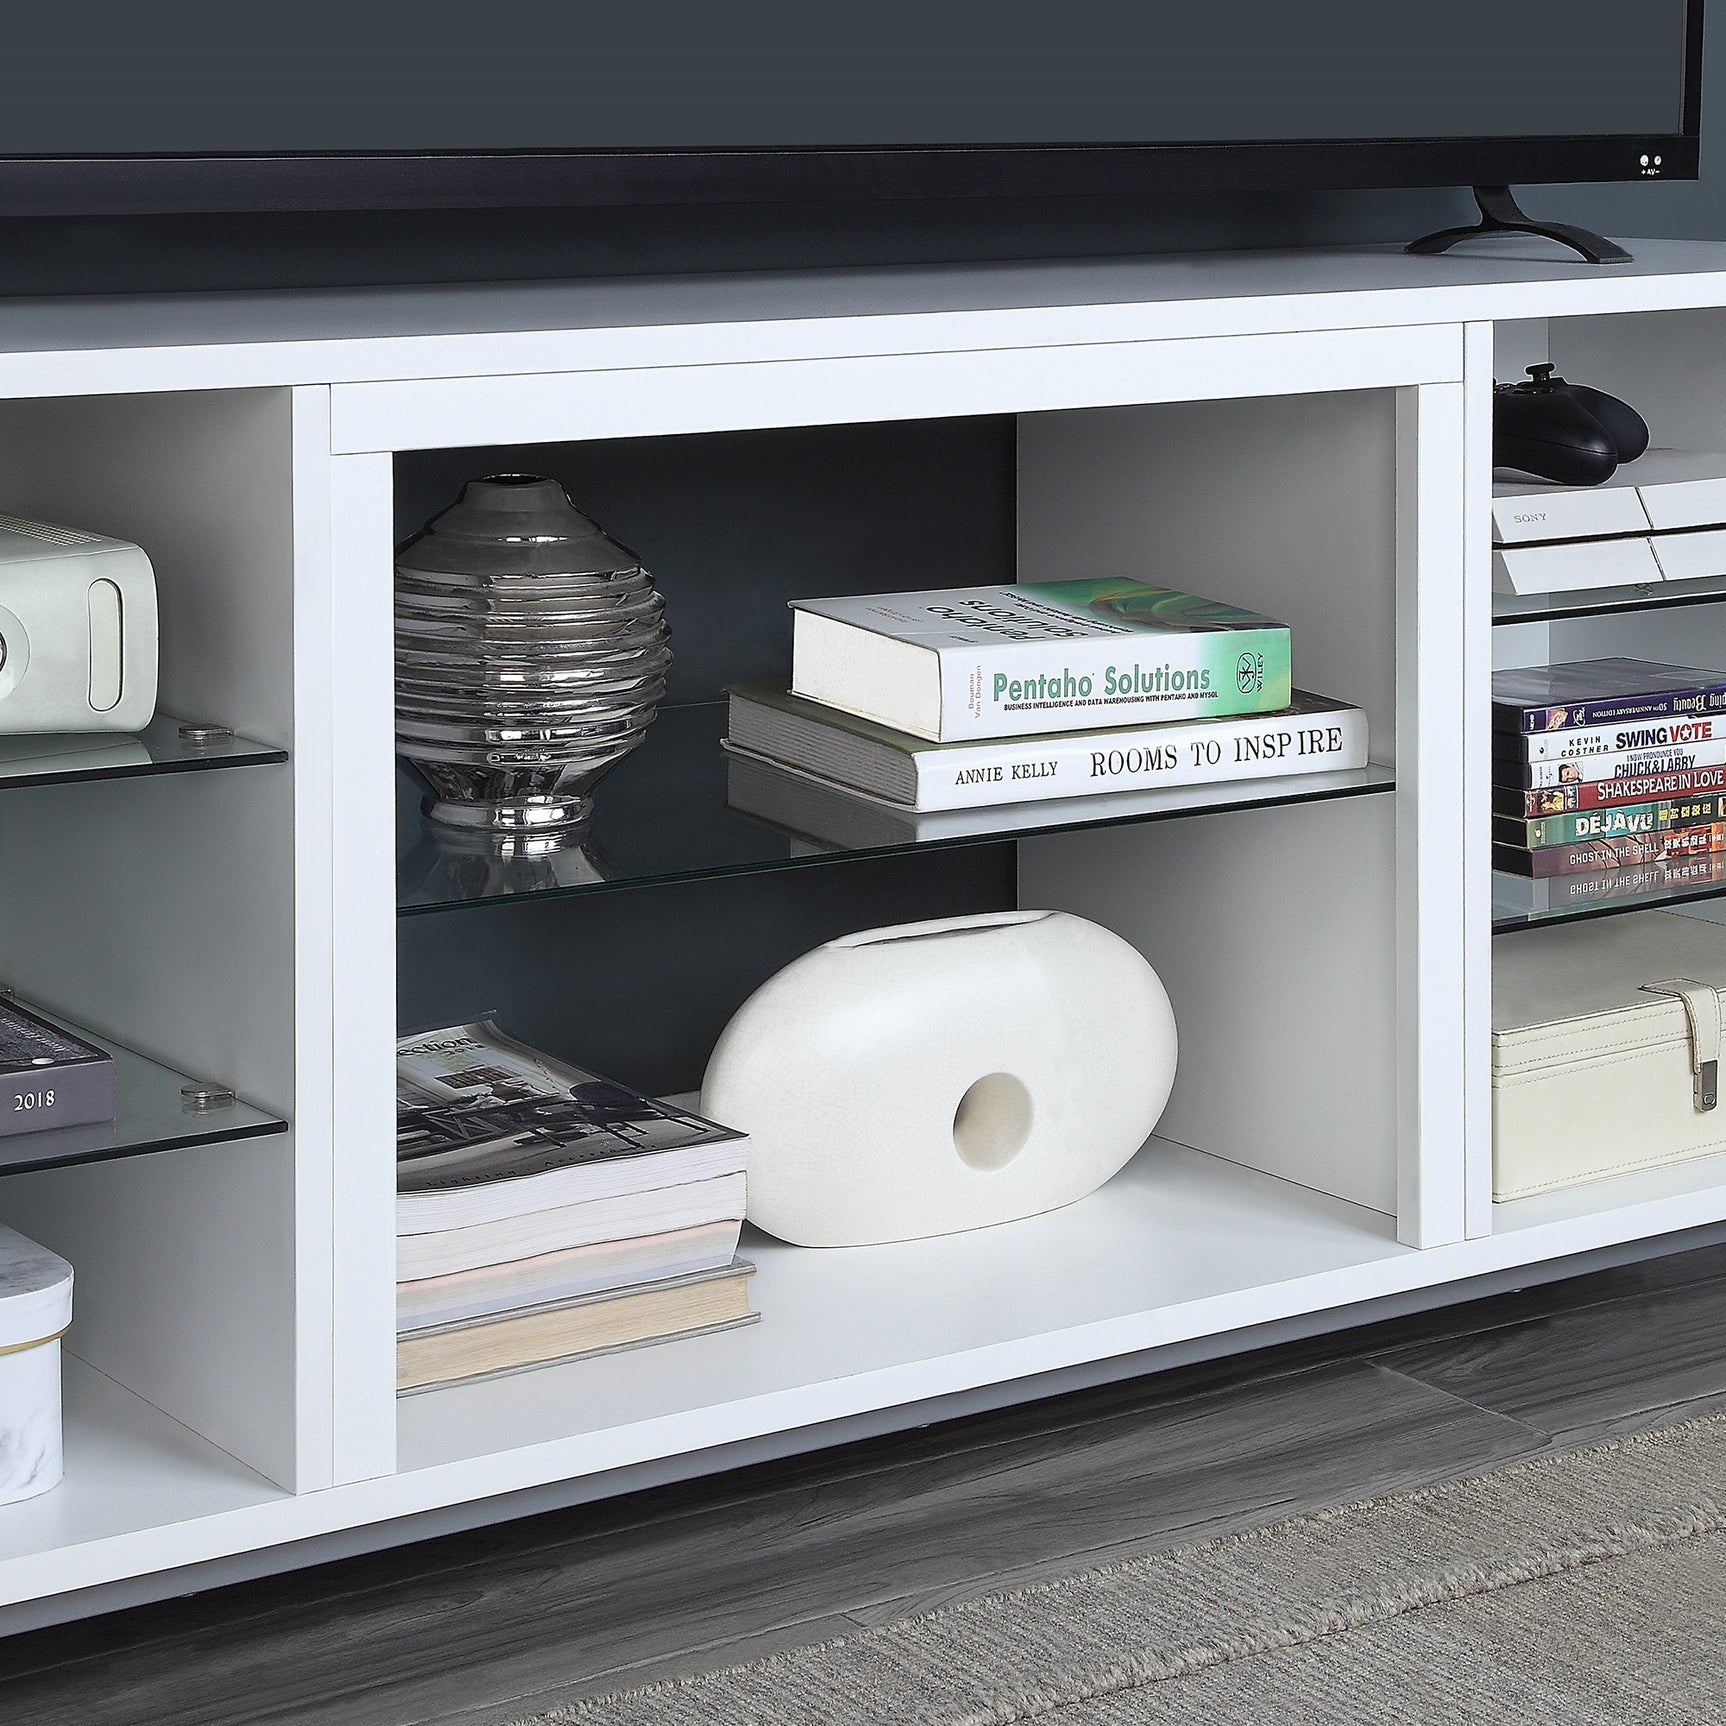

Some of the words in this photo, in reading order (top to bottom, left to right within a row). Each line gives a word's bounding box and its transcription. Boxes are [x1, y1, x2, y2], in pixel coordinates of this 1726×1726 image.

[1514, 513, 1547, 523] SONY
[926, 605, 1046, 641] Pentaho
[958, 600, 1089, 638] Solutions
[975, 665, 983, 699] Dongen
[993, 667, 1095, 702] Pentaho
[1104, 663, 1211, 696] Solutions
[1256, 652, 1264, 693] WILEY
[967, 673, 975, 710] Bouman
[1003, 702, 1033, 711] BUSINESS
[1033, 699, 1074, 710] INTELLIGENCE
[1074, 699, 1088, 707] AND
[1088, 698, 1103, 706] DATA
[1104, 695, 1145, 705] WAREHOUSING
[1145, 694, 1160, 702] WITH
[1160, 693, 1187, 701] PENTAHO
[1187, 692, 1199, 700] AND
[1199, 691, 1219, 699] MYSQL
[1673, 694, 1707, 711] Beauty
[1592, 709, 1616, 718] EDITION
[1615, 705, 1653, 715] ANNIVERSARY
[1569, 735, 1601, 747] KEVIN
[1615, 727, 1668, 749] SWING
[1669, 721, 1713, 743] VOTE
[954, 767, 1003, 785] ANNIE
[1011, 761, 1058, 780] KELLY
[1089, 745, 1178, 777] ROOMS
[1190, 740, 1222, 766] TO
[1233, 727, 1344, 762] INSPIRE
[1630, 752, 1642, 761] NOW
[1643, 749, 1673, 760] PRONOUNCE
[1673, 747, 1684, 756] YOU
[1597, 776, 1678, 800] SHAKESPEARE
[1678, 774, 1691, 790] IN
[1693, 768, 1724, 787] LOVE
[1569, 850, 1601, 865] GHOST
[1601, 848, 1612, 860] IN
[1613, 845, 1631, 858] THE
[1632, 842, 1659, 856] SHELL
[14, 1089, 56, 1111] 2018
